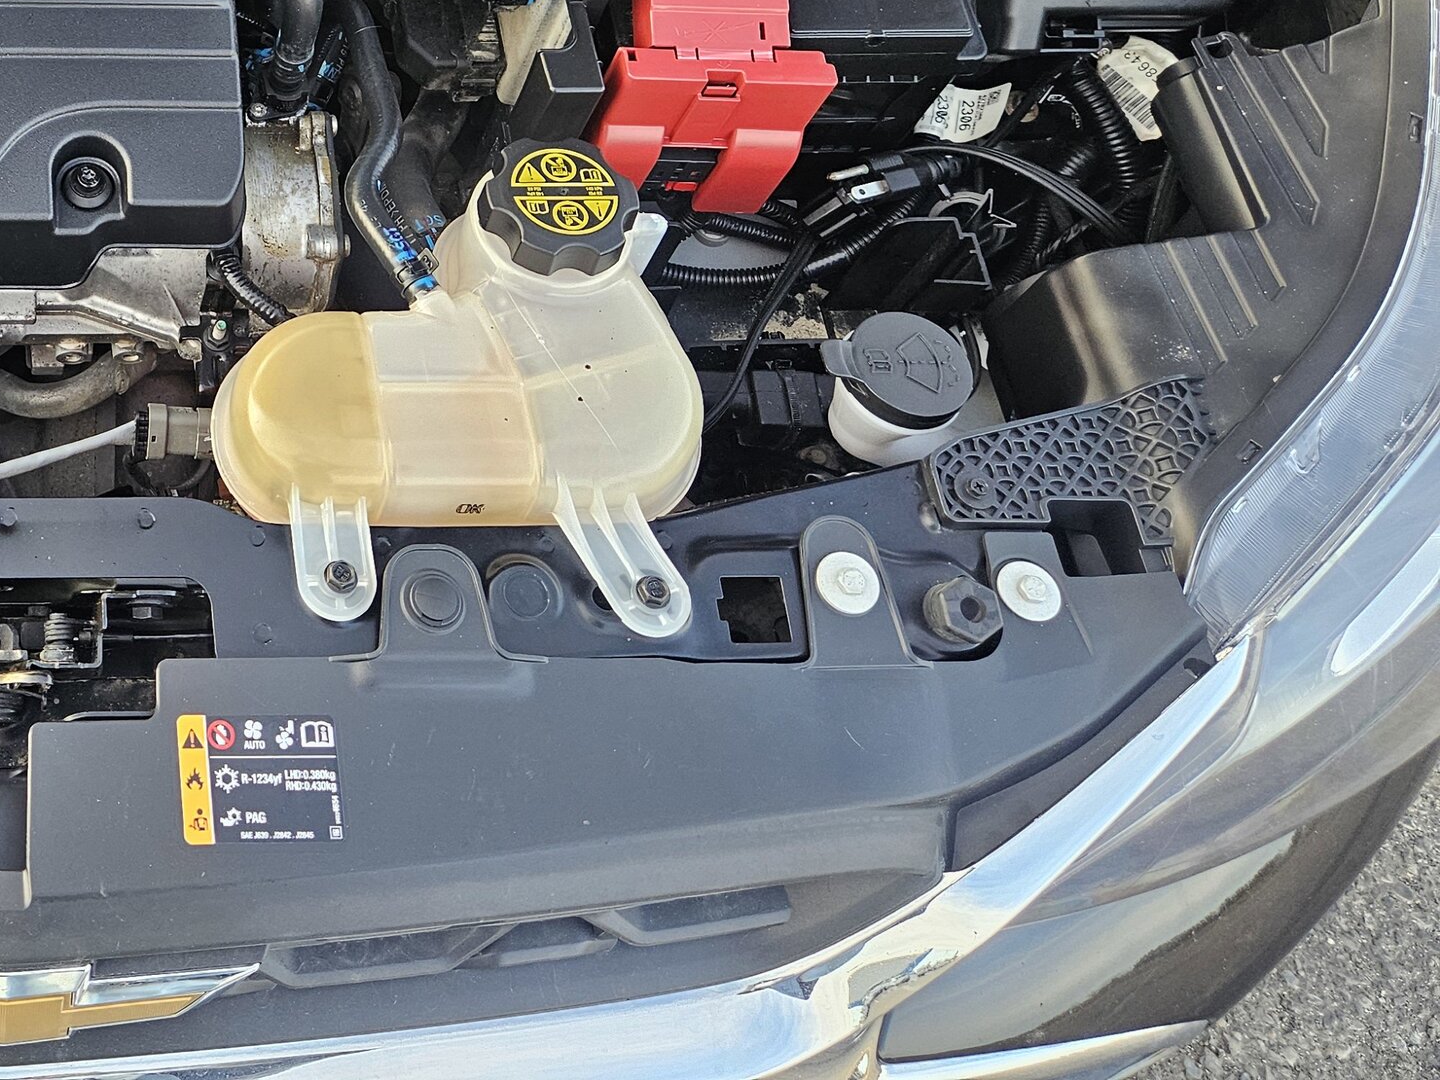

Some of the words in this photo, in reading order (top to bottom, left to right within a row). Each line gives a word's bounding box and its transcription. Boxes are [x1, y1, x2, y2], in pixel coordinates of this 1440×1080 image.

[959, 100, 975, 131] 2306
[244, 740, 266, 750] AUTO
[241, 772, 282, 787] R-1234yf
[245, 811, 268, 824] PAG
[240, 831, 253, 839] SAE
